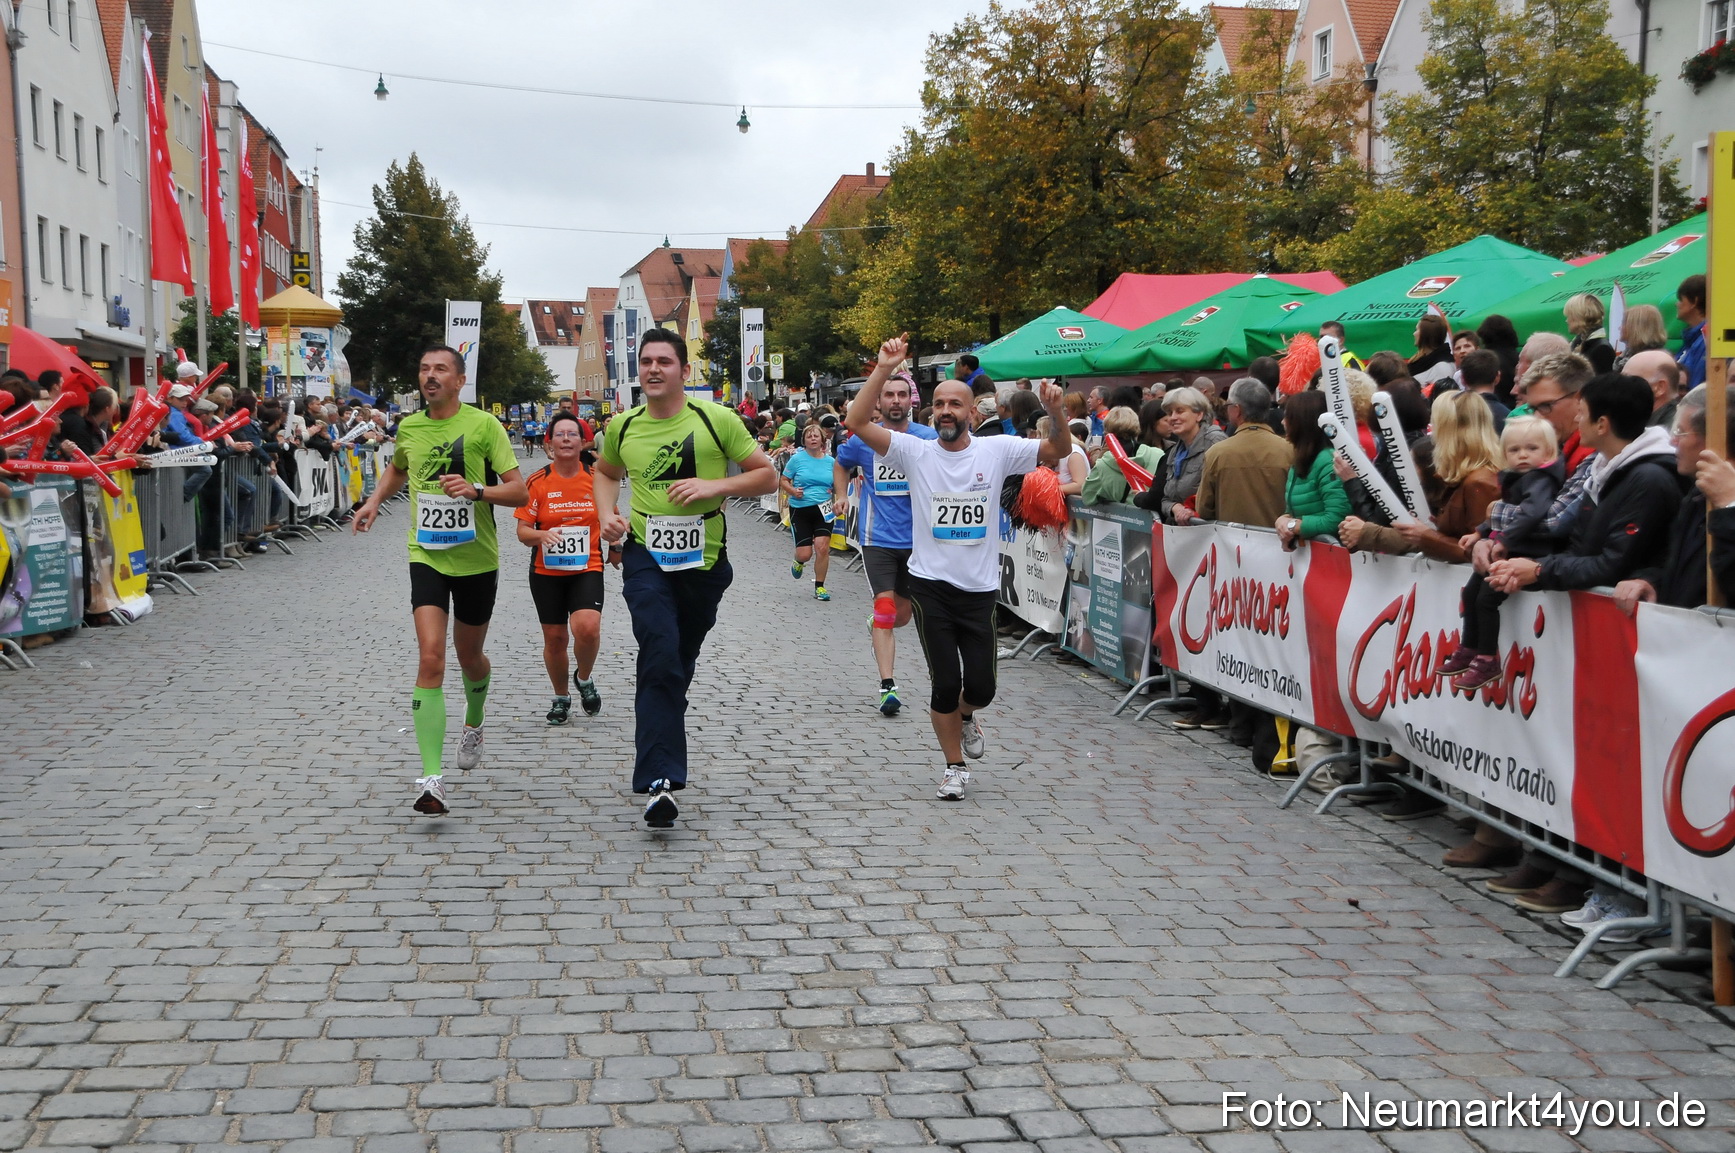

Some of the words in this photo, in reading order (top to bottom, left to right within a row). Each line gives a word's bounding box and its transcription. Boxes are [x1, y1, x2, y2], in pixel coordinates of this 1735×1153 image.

[1364, 301, 1460, 310] Neumarter
[452, 317, 478, 327] swn
[746, 323, 763, 331] swn
[1035, 347, 1092, 356] Lamms
[1381, 427, 1403, 465] BMW
[417, 452, 438, 478] GOSSEN
[642, 451, 667, 478] GOSSEN
[549, 501, 593, 509] SportScheck
[937, 505, 984, 524] 2769
[422, 508, 469, 529] 2238
[430, 533, 458, 543] Jürgen
[652, 529, 700, 550] 2330
[661, 555, 688, 564] Roman
[1178, 542, 1294, 655] Charivari
[1216, 650, 1270, 689] Ostbayerns
[1272, 669, 1302, 701] Radio
[1404, 722, 1501, 782] Ostbayerns
[1507, 756, 1556, 805] Radio
